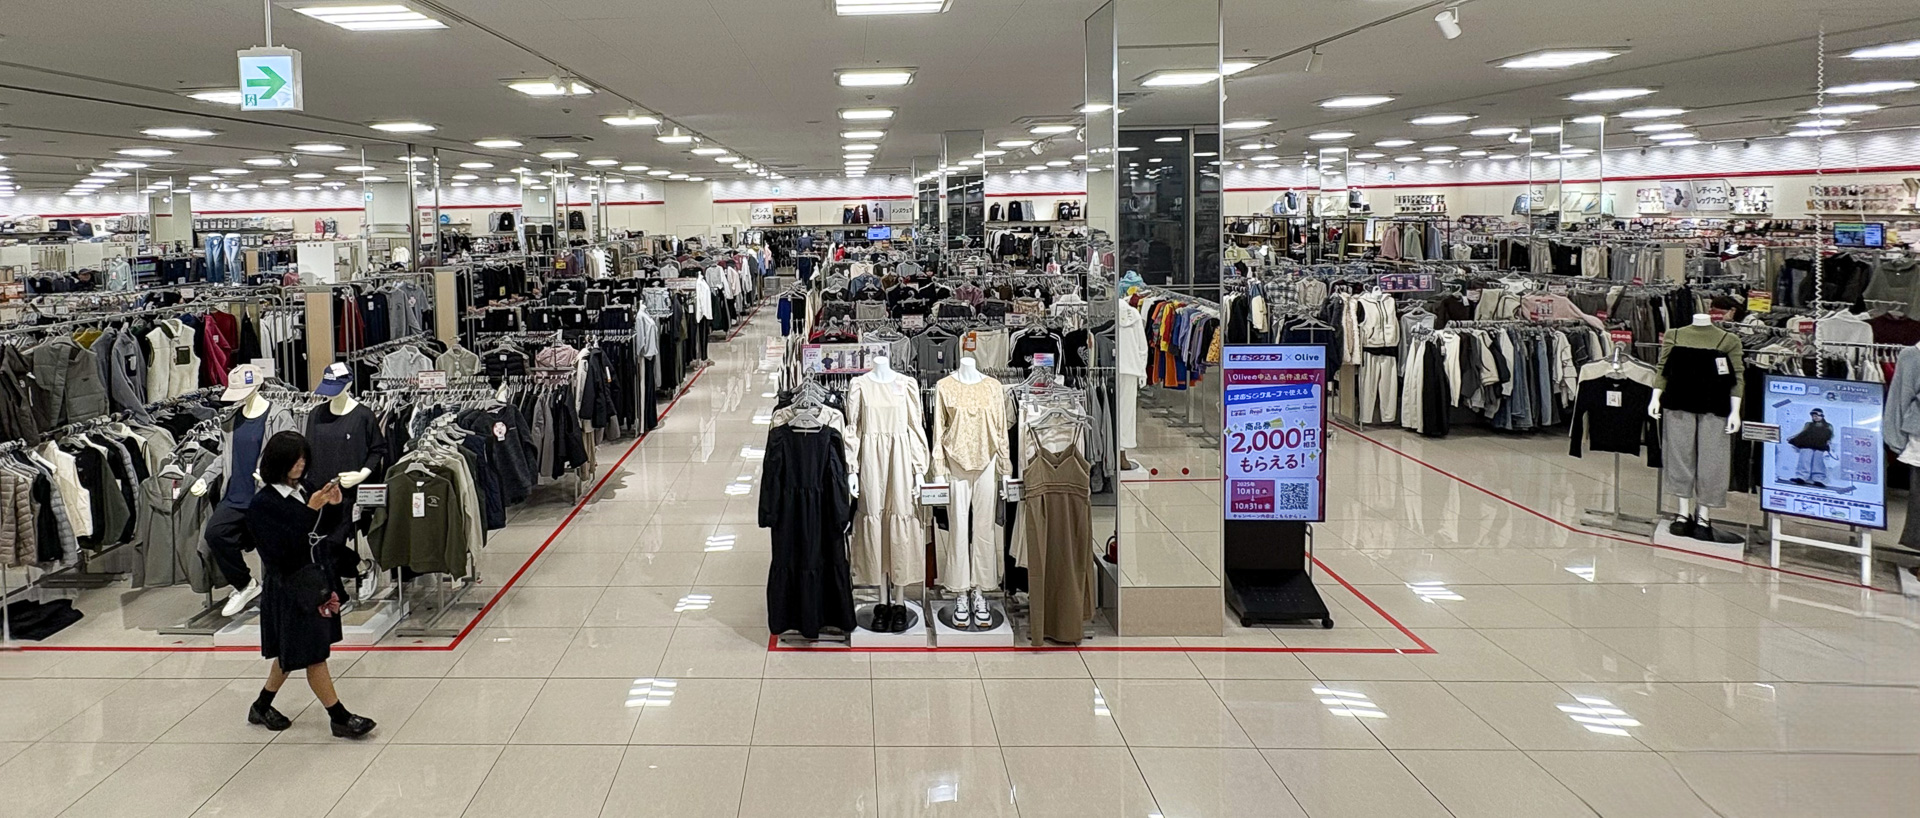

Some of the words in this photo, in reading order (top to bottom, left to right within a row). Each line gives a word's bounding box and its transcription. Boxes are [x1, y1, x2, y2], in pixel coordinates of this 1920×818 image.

[1696, 186, 1723, 194] レディース
[1295, 353, 1319, 361] Olive
[1772, 383, 1803, 392] Helm
[1245, 421, 1271, 431] 商品券
[1854, 439, 1871, 447] 990
[1854, 456, 1871, 464] 990
